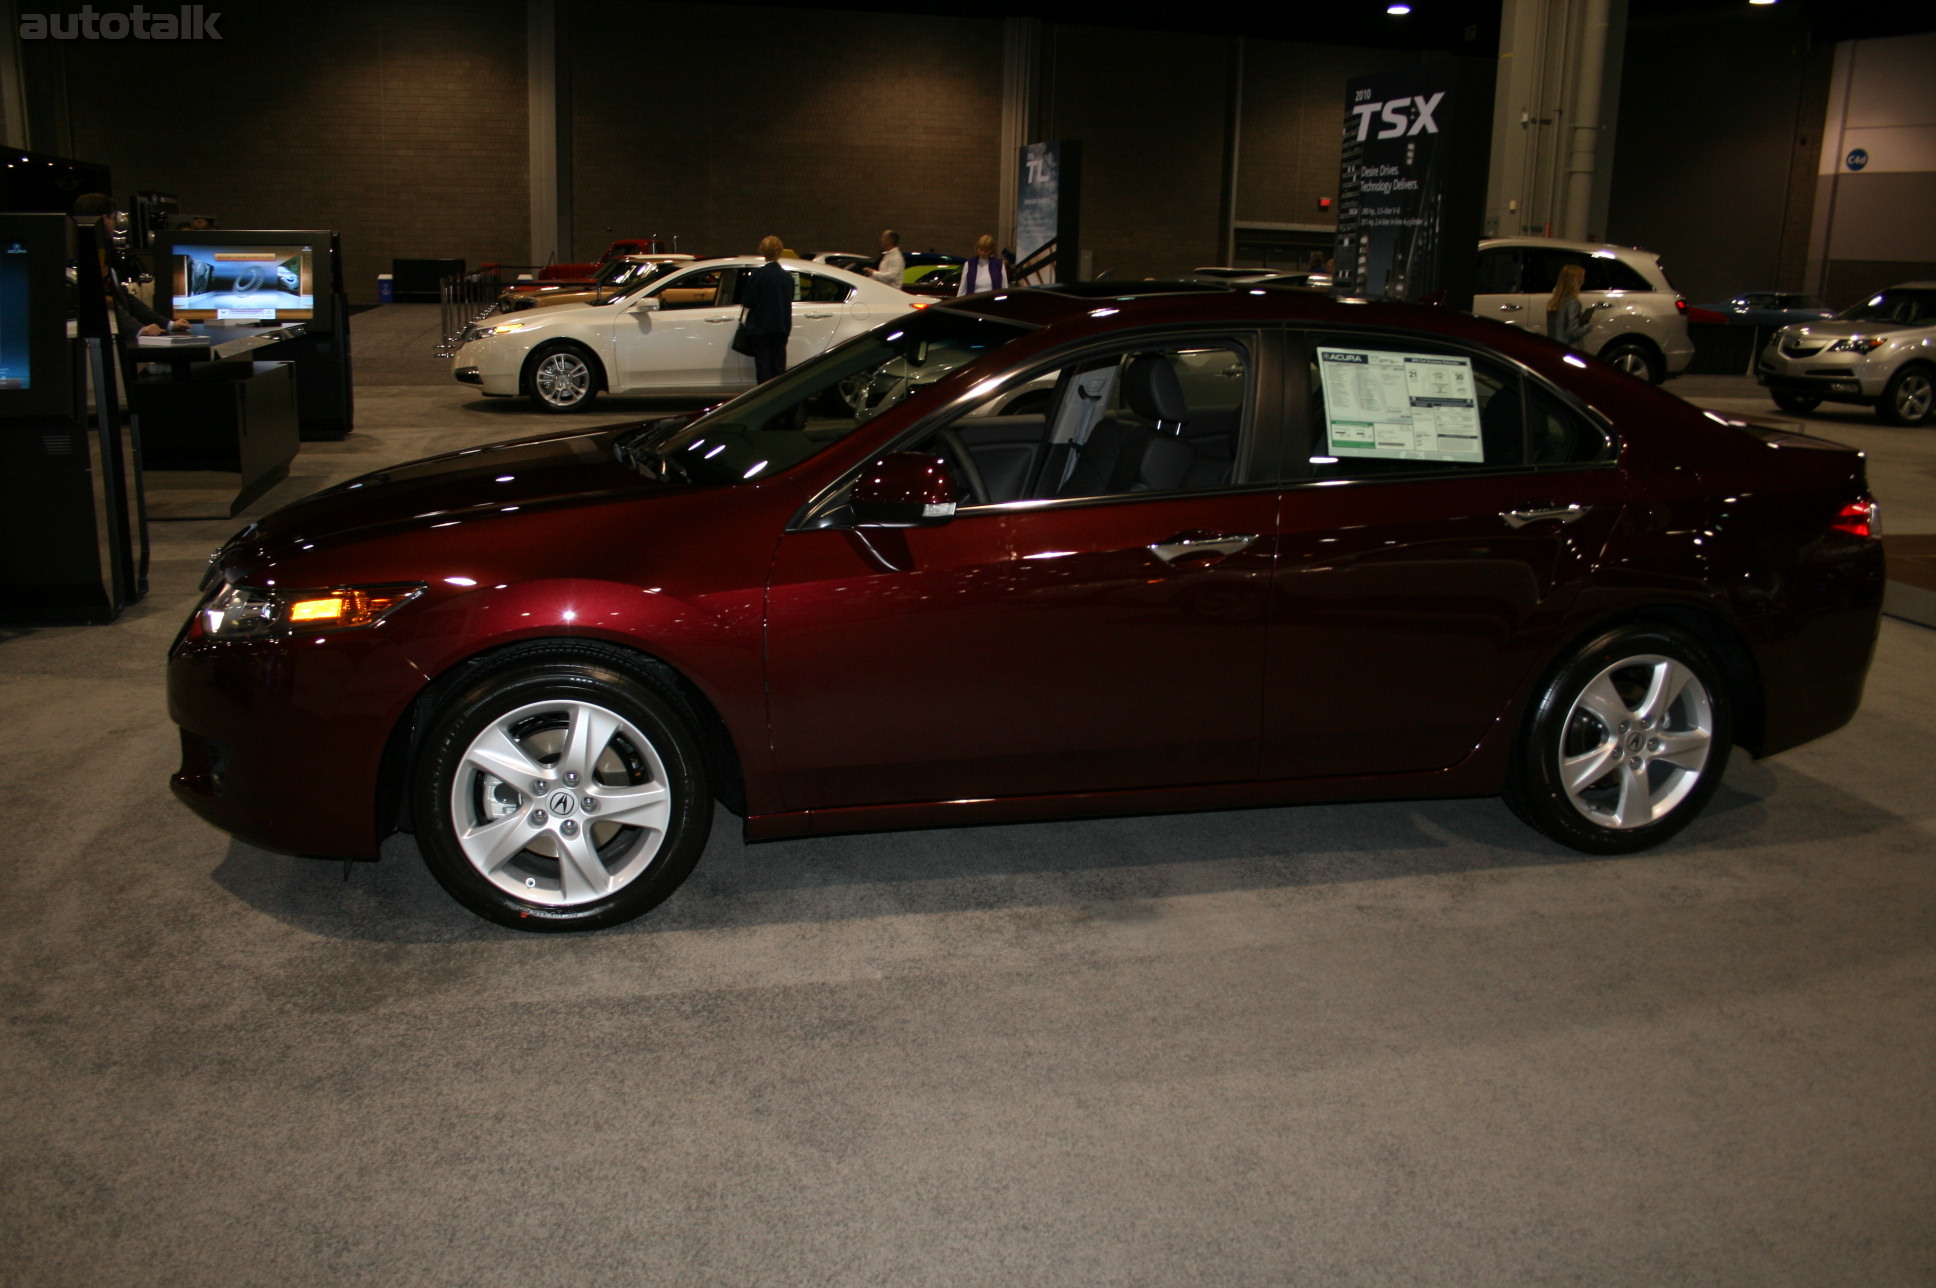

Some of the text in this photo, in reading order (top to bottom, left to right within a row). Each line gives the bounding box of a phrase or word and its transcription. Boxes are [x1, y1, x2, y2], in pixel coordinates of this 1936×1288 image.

[1355, 88, 1371, 101] 2010
[1352, 91, 1446, 142] TSX
[1026, 159, 1050, 184] TL
[1361, 164, 1399, 177] Desire Drives.
[1360, 178, 1419, 195] Technology Delivers.
[1329, 354, 1362, 363] ACURA
[1408, 370, 1418, 379] 21
